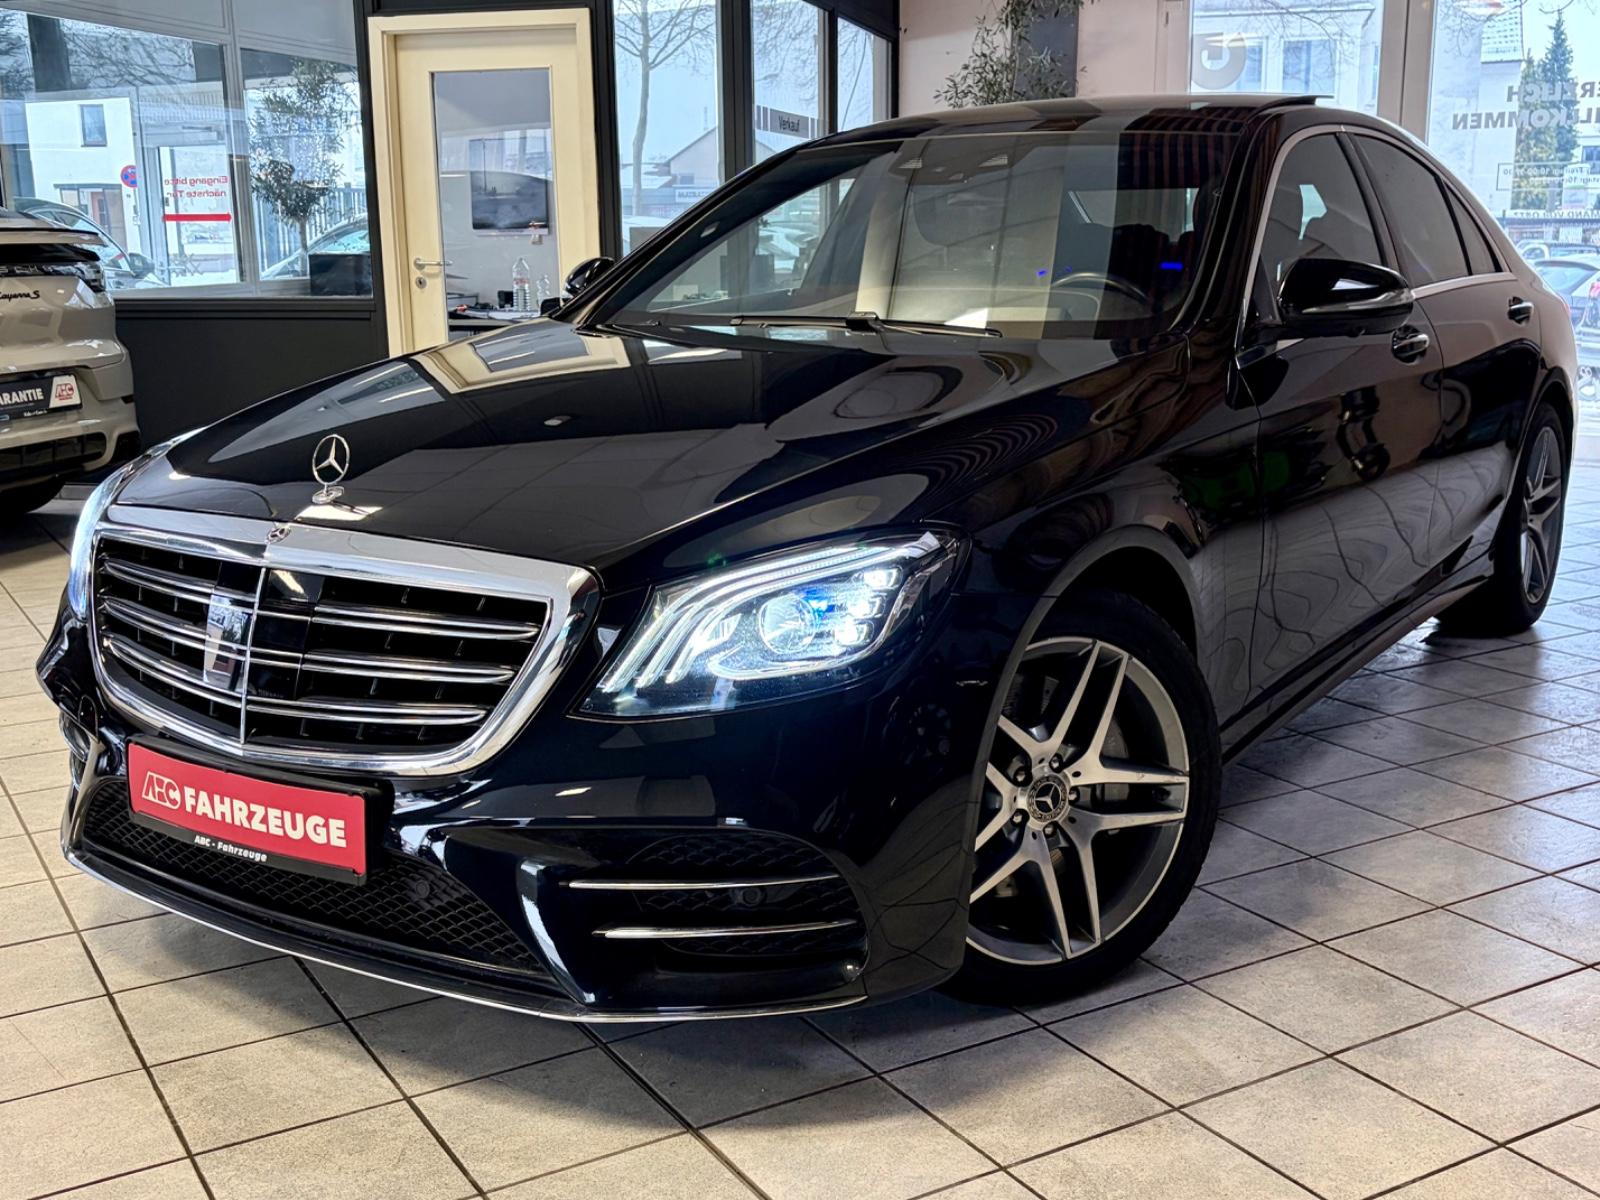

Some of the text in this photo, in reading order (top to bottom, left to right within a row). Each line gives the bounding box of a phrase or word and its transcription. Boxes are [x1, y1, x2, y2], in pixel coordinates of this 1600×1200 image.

[778, 115, 800, 132] Verkauf
[30, 290, 40, 299] S
[183, 786, 347, 848] FAHRZEUGE
[194, 835, 211, 847] ABC
[217, 841, 268, 862] Fahrzeuge
